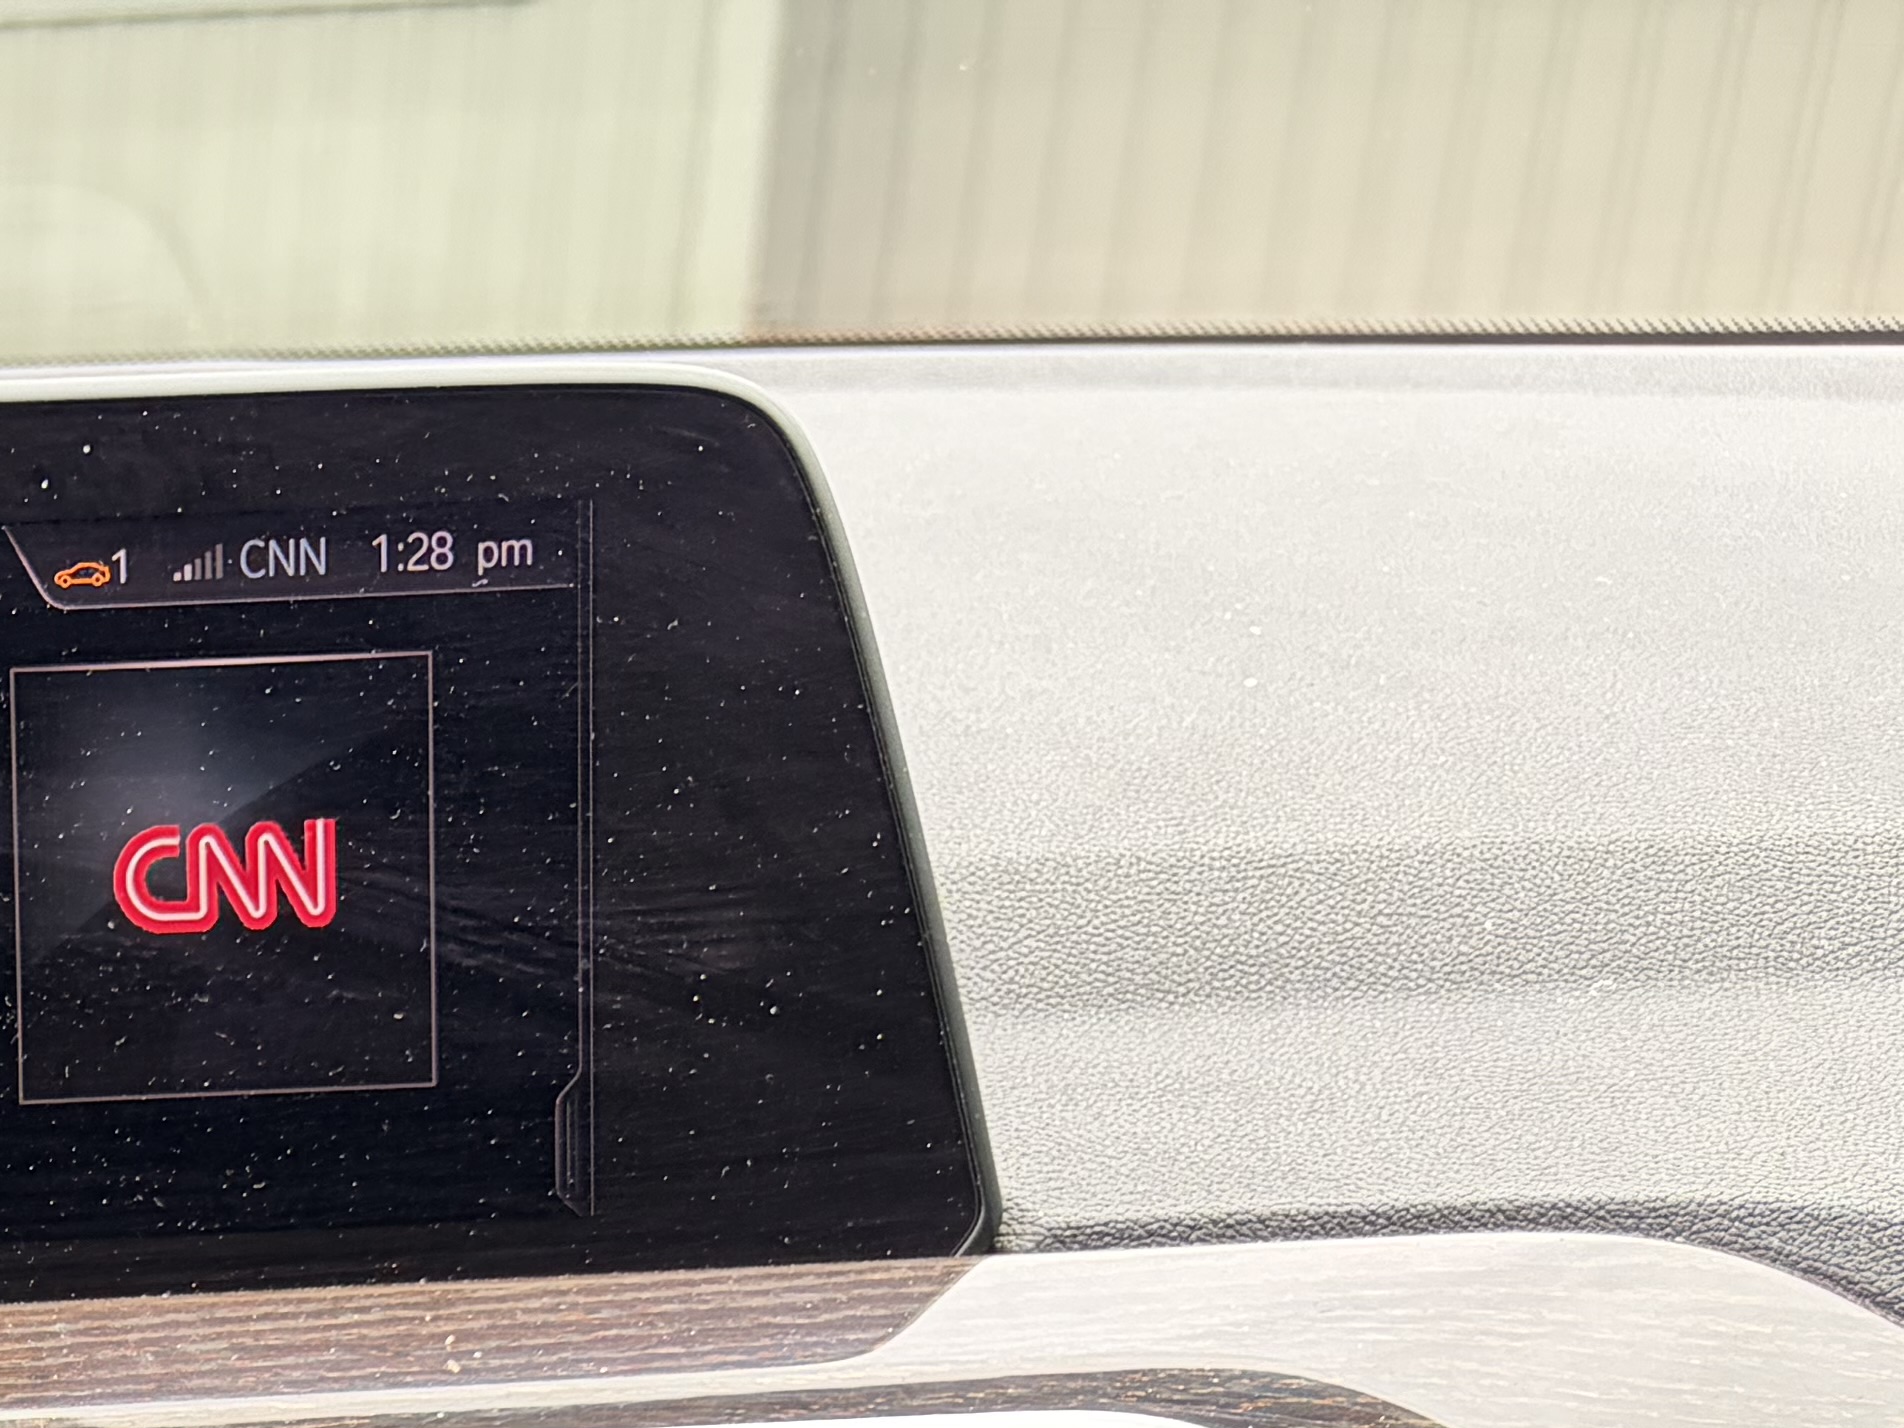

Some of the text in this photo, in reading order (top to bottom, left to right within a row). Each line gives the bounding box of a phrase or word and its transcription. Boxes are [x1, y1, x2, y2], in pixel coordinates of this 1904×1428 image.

[239, 538, 328, 578] CNN
[371, 532, 454, 573] 1:28
[477, 536, 533, 576] pm
[114, 818, 336, 934] CNN
